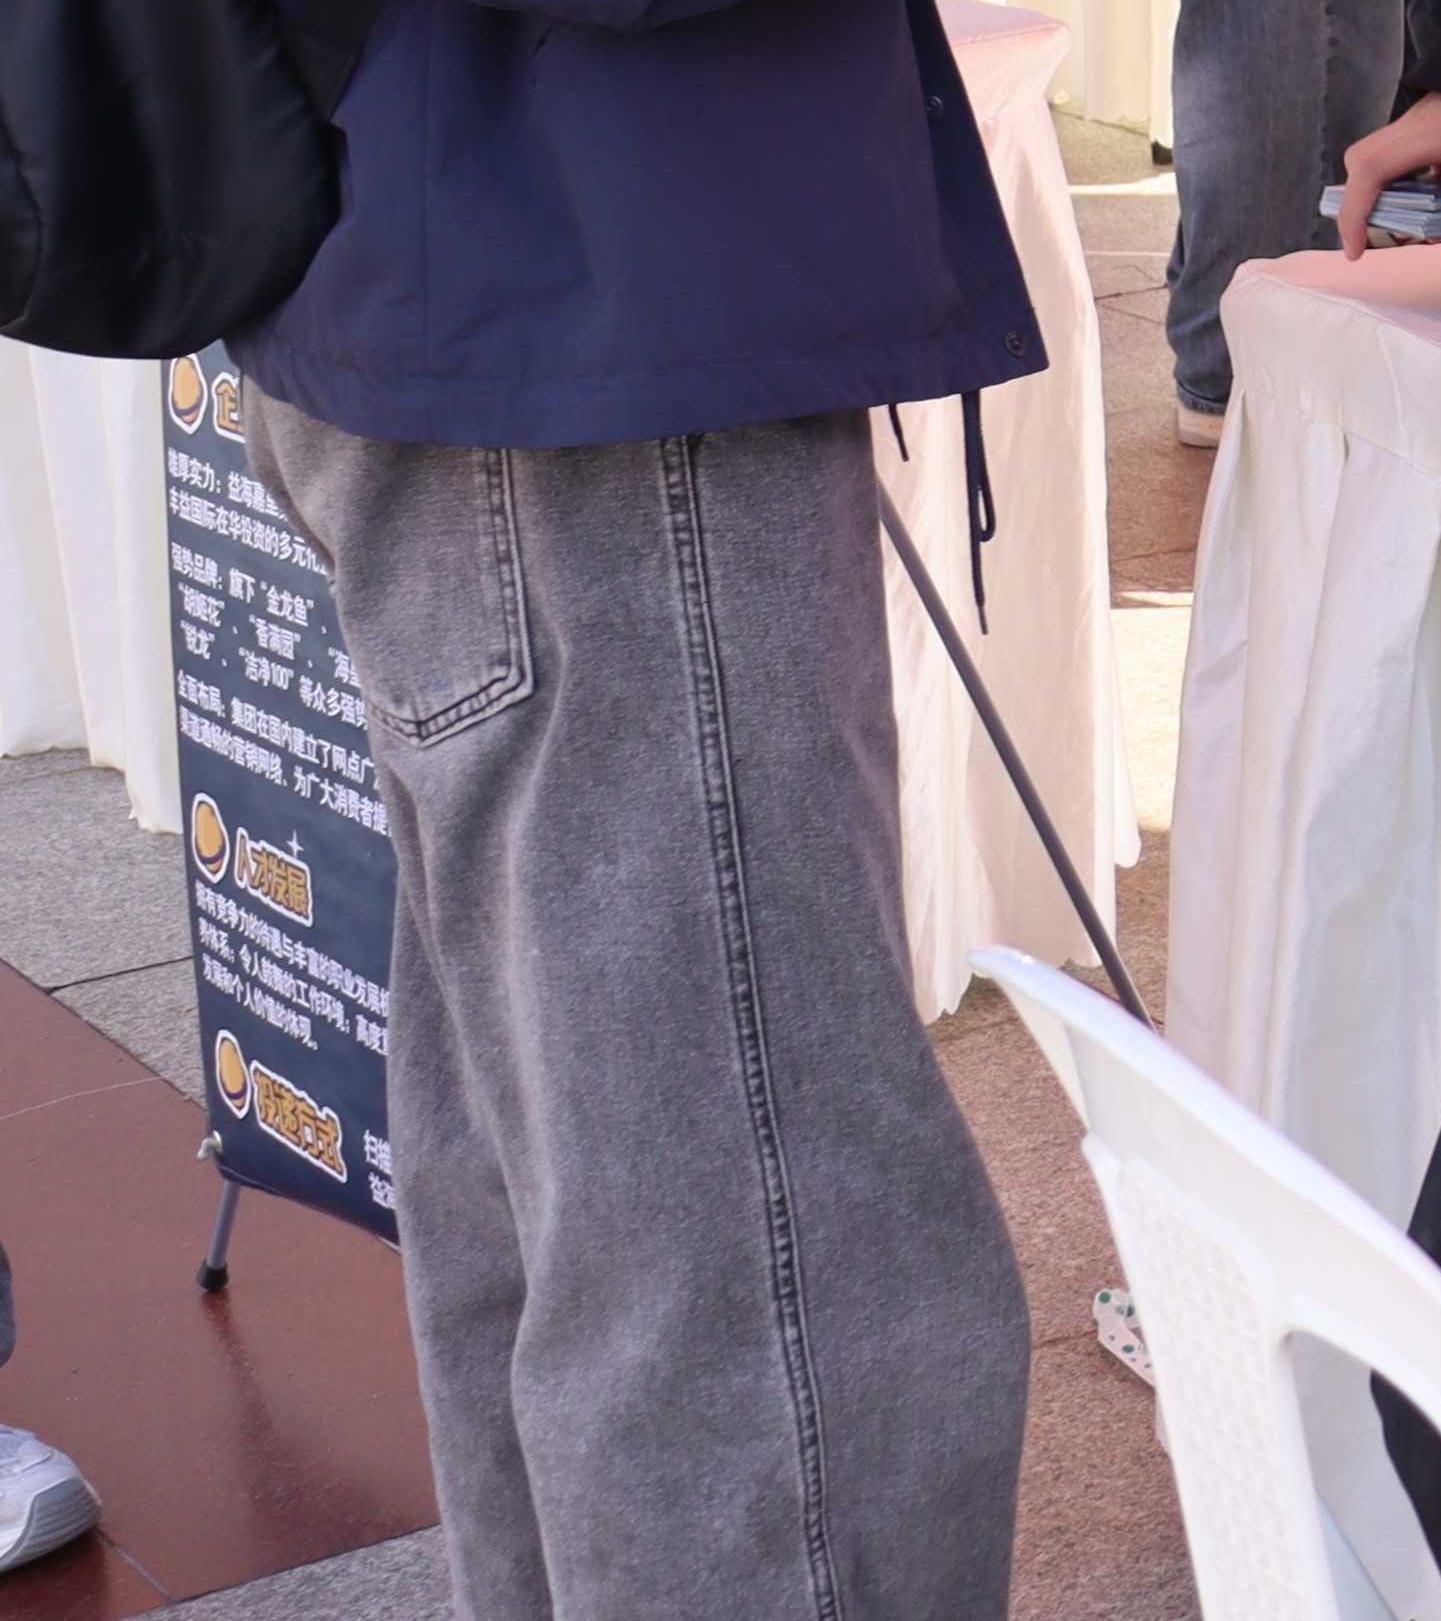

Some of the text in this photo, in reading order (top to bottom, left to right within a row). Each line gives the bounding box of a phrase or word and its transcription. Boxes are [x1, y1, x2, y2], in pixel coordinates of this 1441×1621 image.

[168, 446, 288, 523] 雄厚实力：益海嘉里
[178, 669, 380, 790] 全面布局：集团在国内建立了网点广
[237, 833, 310, 921] 人才发展
[253, 1067, 344, 1174] 投递方式
